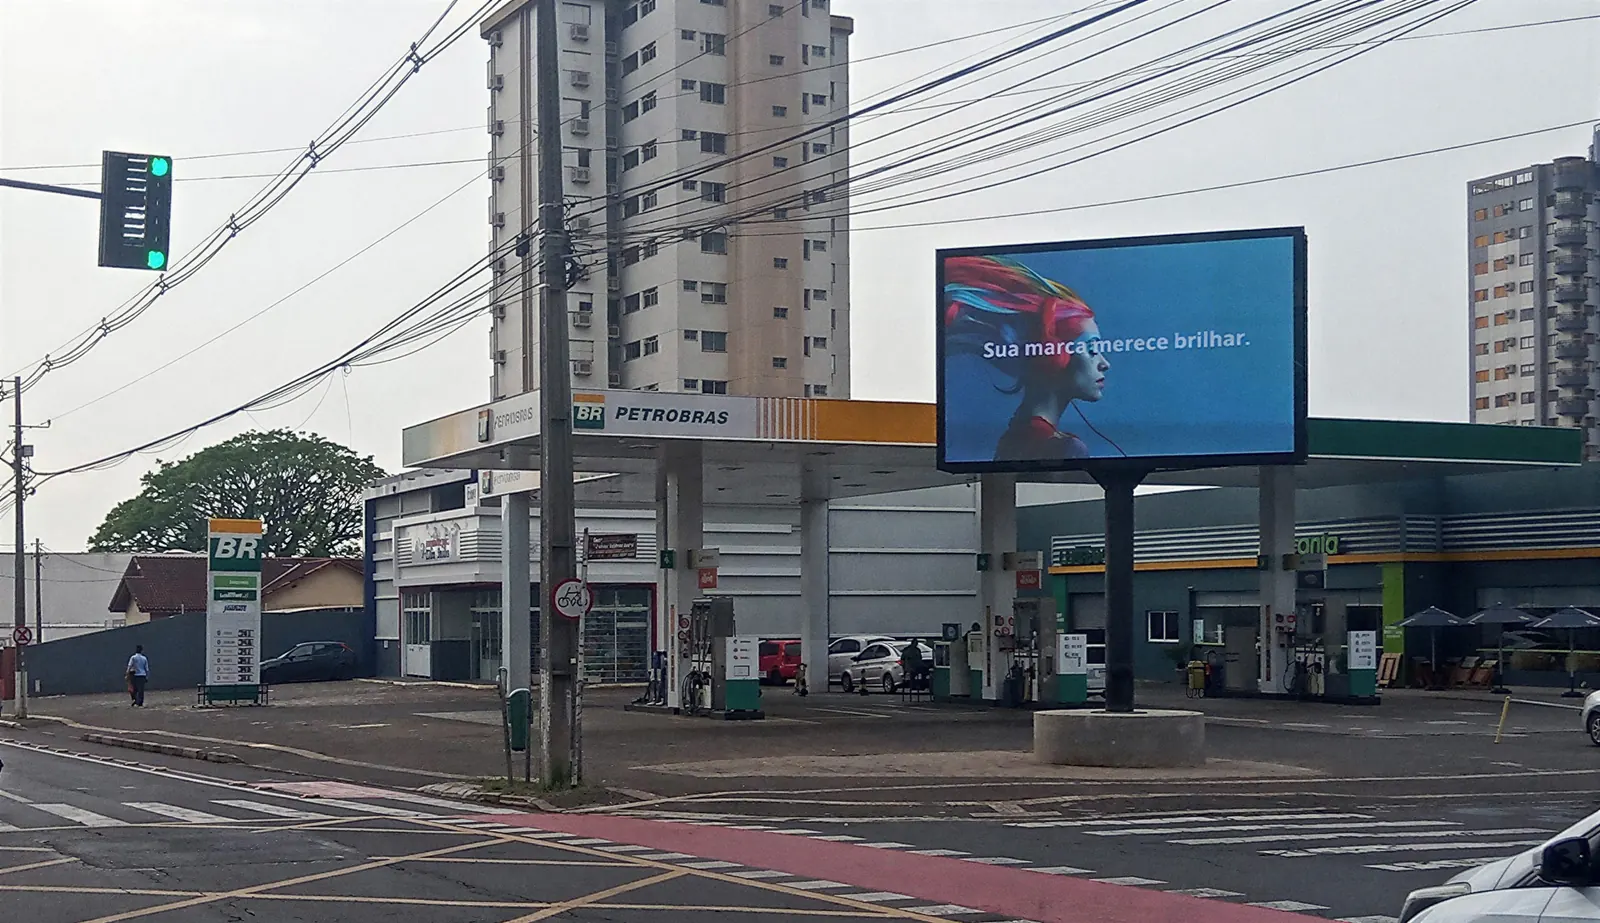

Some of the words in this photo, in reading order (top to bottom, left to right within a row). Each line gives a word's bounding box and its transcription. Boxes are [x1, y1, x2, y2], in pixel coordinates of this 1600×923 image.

[983, 341, 1019, 359] Sua
[1025, 339, 1090, 357] marca
[1093, 336, 1168, 354] merece
[1174, 330, 1250, 350] brilhar.
[576, 406, 604, 421] BR
[615, 406, 729, 425] PETROBRAS
[214, 535, 258, 559] BR
[1295, 534, 1338, 555] ania
